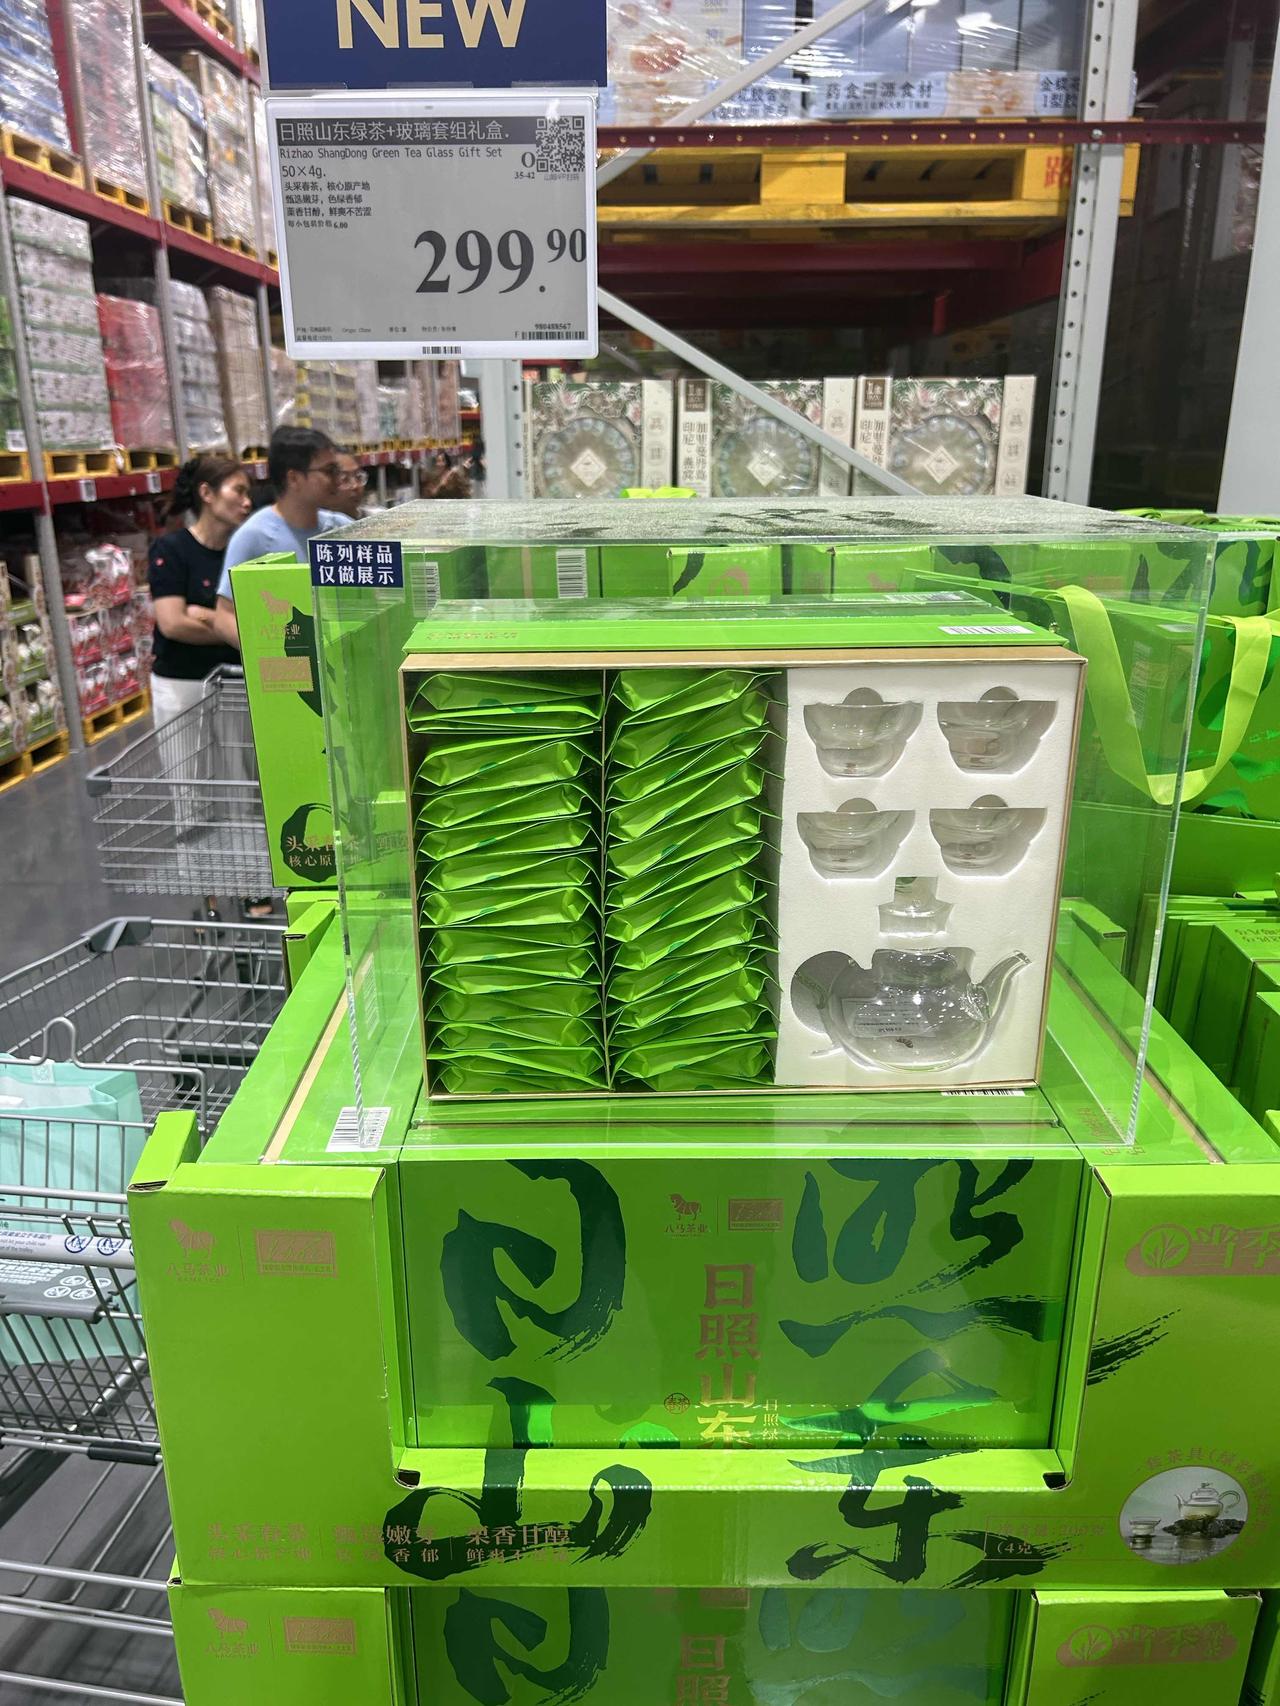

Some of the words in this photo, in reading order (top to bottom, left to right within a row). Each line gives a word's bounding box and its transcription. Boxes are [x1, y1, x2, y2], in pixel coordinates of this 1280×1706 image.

[335, 0, 527, 49] NEW
[280, 148, 313, 160] Rizhao
[318, 148, 367, 160] ShangDong
[372, 148, 399, 158] Green
[405, 147, 422, 158] Tea
[426, 147, 454, 158] Glass
[459, 147, 481, 158] Gift
[486, 147, 503, 158] Set
[316, 544, 393, 563] 陈列样品
[319, 565, 394, 584] 仅做展示
[666, 1223, 709, 1234] 八马茶业
[695, 1263, 761, 1449] 日照山东
[466, 1525, 571, 1546] 栗香甘醇
